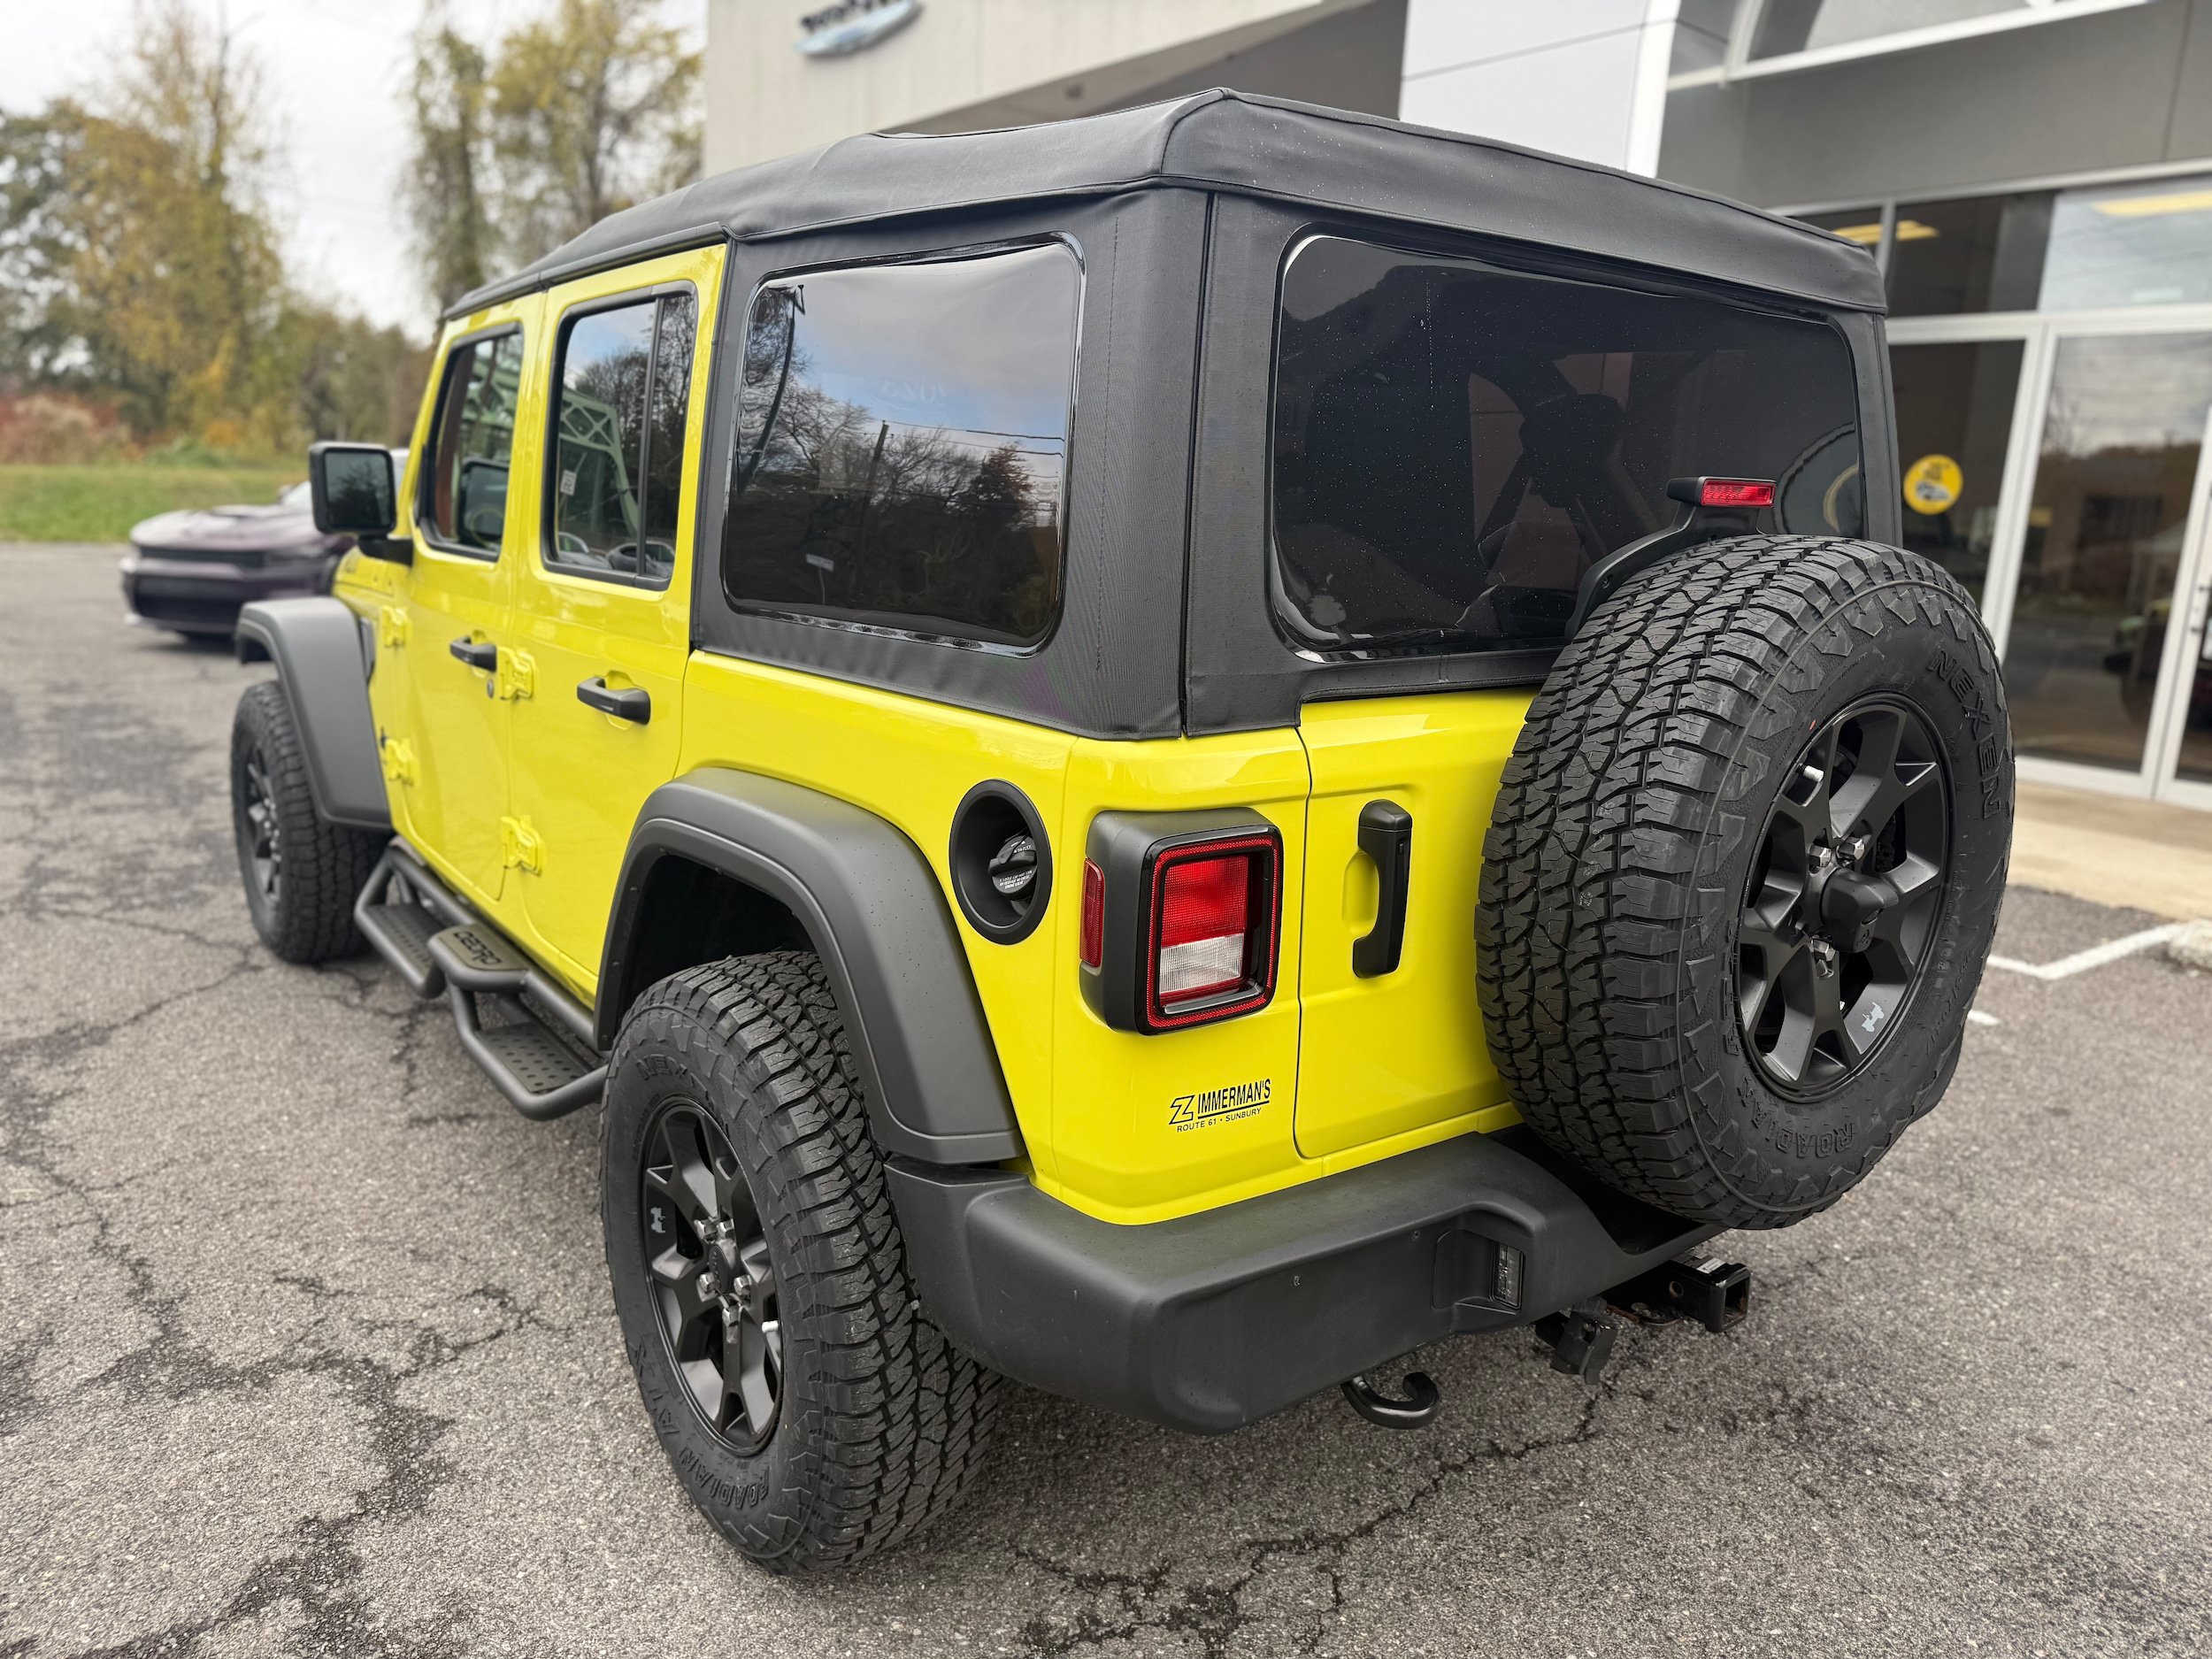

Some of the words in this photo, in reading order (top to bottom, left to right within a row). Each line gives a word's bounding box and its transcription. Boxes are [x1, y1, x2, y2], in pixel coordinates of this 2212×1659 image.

[1924, 649, 2001, 819] NEXEN
[1168, 1078, 1271, 1125] ZIMMERMAN'S
[1177, 1120, 1205, 1133] ROUTE
[1208, 1118, 1217, 1126] 61
[1225, 1108, 1262, 1122] SUNBURY
